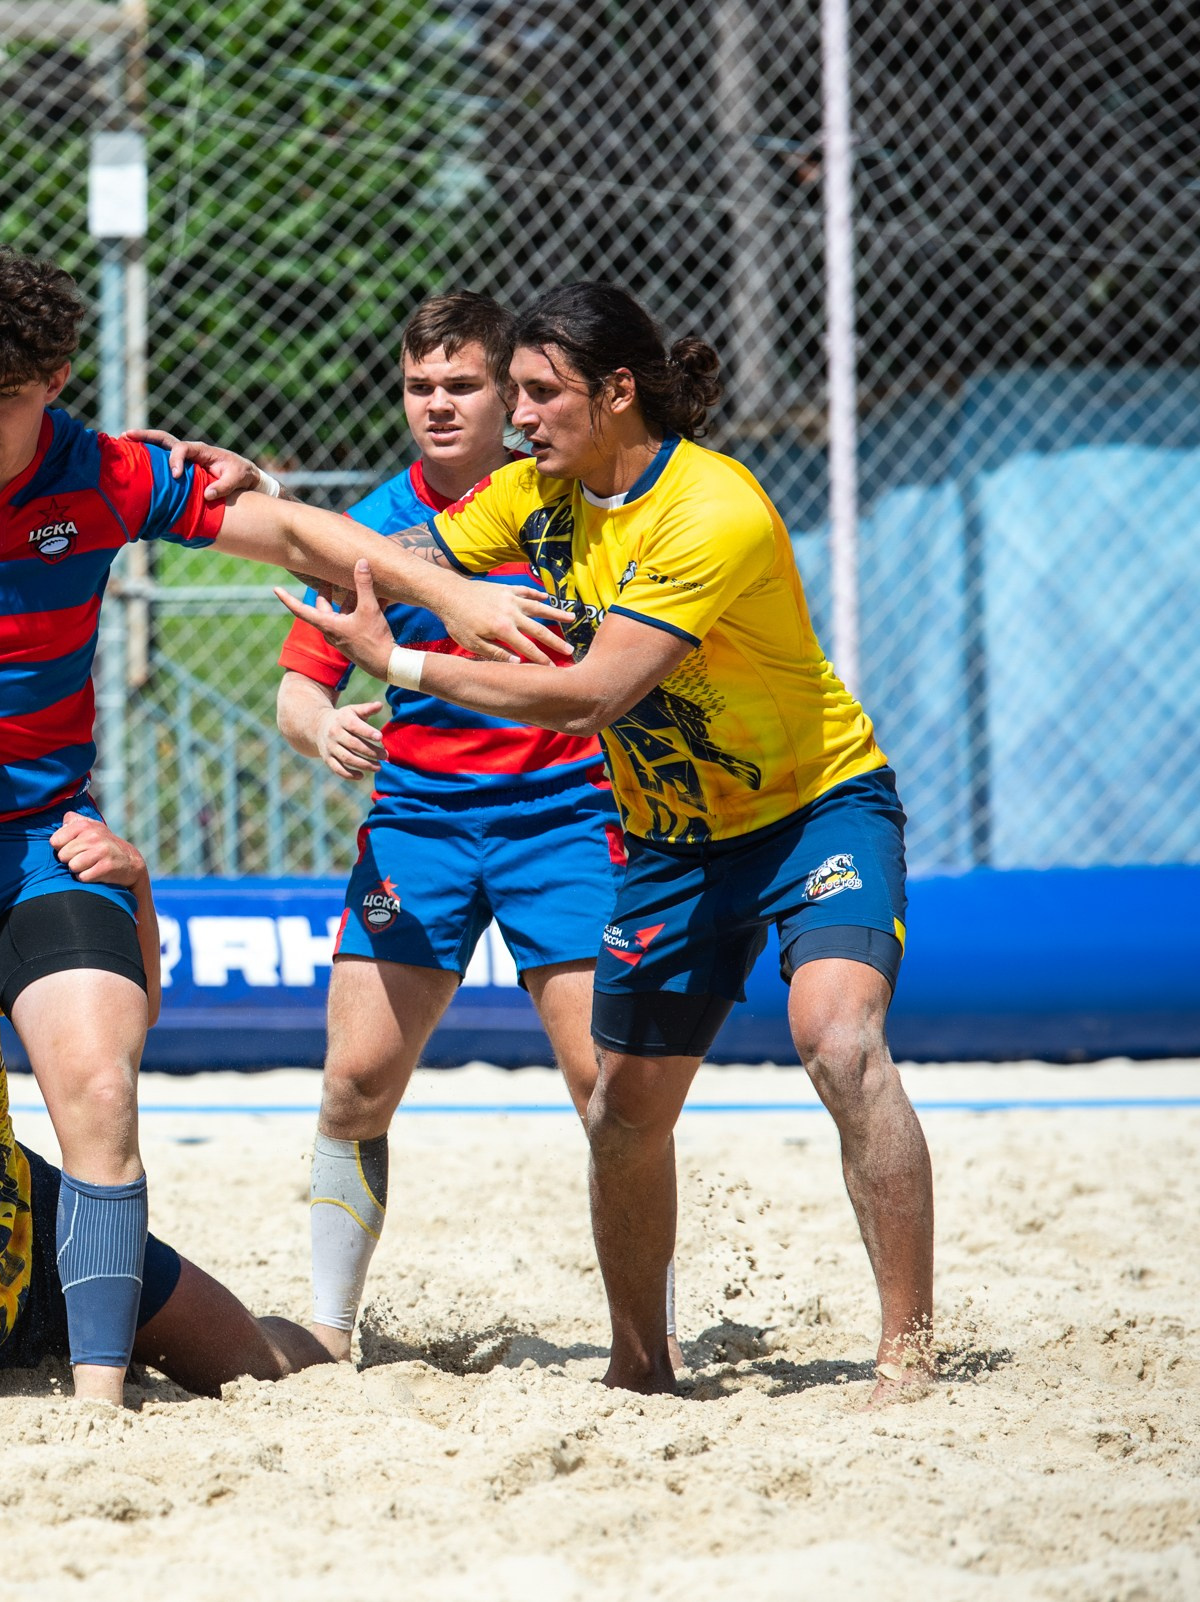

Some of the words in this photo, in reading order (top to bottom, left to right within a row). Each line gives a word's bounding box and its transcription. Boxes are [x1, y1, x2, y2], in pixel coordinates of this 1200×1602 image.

[28, 521, 79, 543] ЦСКА
[821, 878, 862, 891] РОСТОВ
[363, 895, 401, 913] ЦСКА
